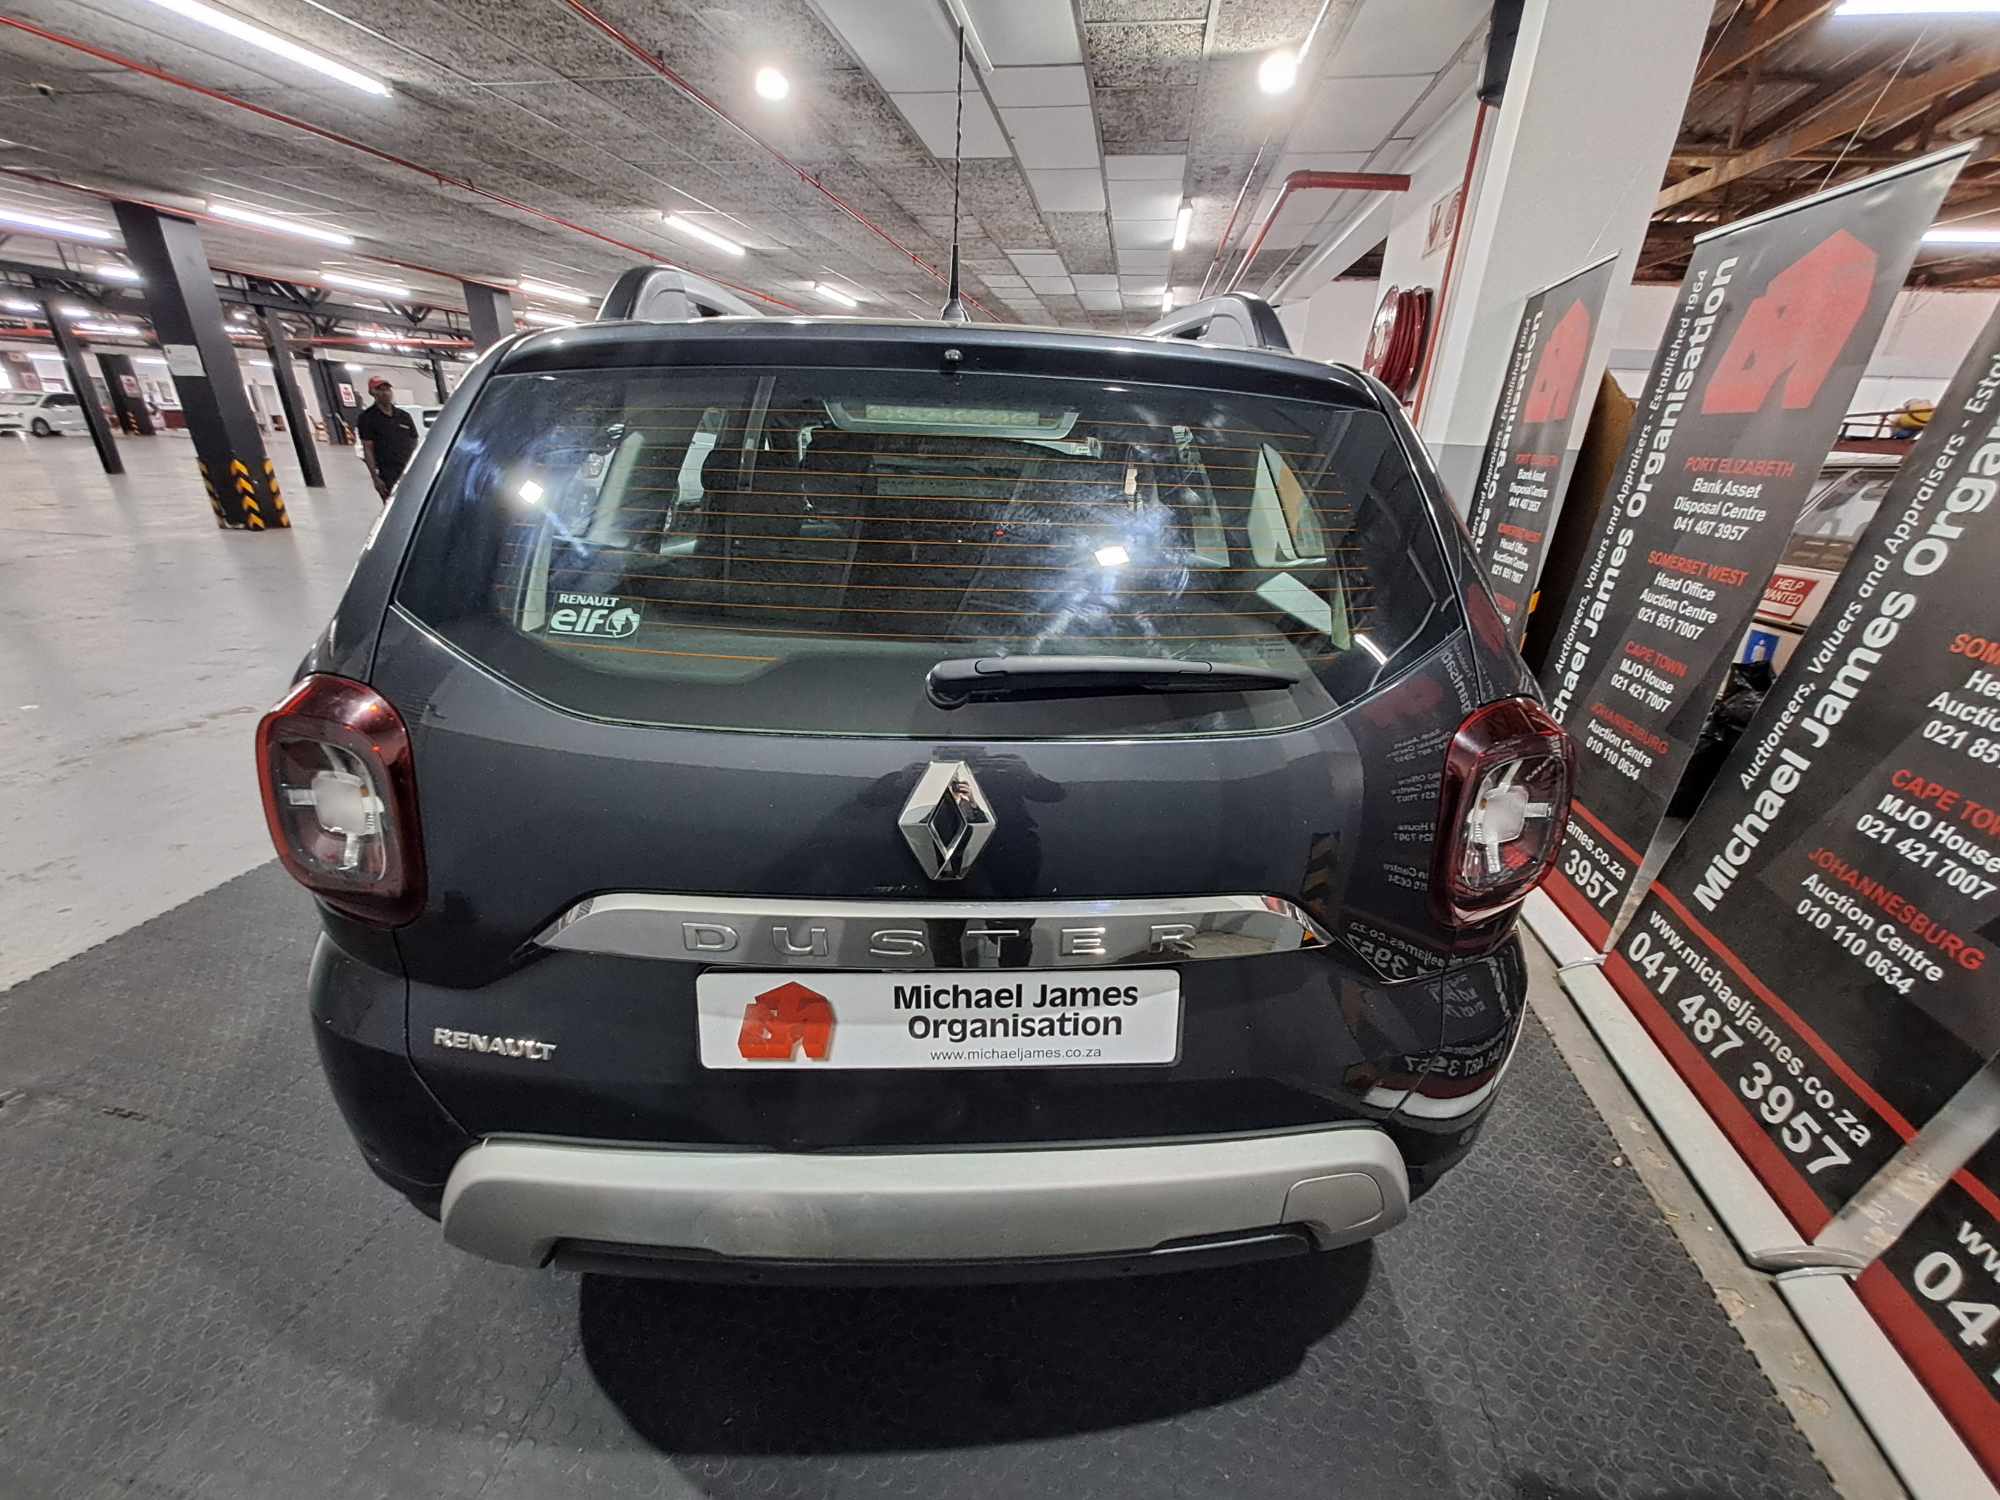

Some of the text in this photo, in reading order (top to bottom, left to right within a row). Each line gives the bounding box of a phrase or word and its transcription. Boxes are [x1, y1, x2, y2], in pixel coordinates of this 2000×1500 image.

[1487, 310, 1544, 500] Organisation
[1584, 527, 1635, 638] James
[1626, 256, 1740, 518] Organisation
[1684, 456, 1796, 478] PORT ELIZABETH
[1555, 594, 1590, 675] Auctioneers,
[1584, 537, 1610, 589] Valuers
[1606, 505, 1621, 536] and
[1617, 424, 1651, 503] Appraisers
[1649, 317, 1691, 412] Established
[1685, 269, 1708, 313] 1964
[1692, 477, 1764, 499] Bank Asset
[1673, 495, 1767, 522] Disposal Centre
[1673, 515, 1750, 542] 041 487 3957
[1648, 550, 1749, 587] SOMERSET WEST
[1654, 571, 1717, 602] Head Office
[1774, 577, 1806, 592] HELP
[550, 607, 608, 633] elf
[558, 592, 620, 608] RENAULT
[1639, 588, 1718, 625] Auction Centre
[1740, 680, 1817, 791] Auctioneers,
[1807, 600, 1863, 676] Valuers
[1857, 553, 1891, 605] and
[1884, 433, 1966, 555] Appraisers
[1637, 607, 1705, 641] 021 851 7007
[1618, 657, 1676, 695] MJO House
[1624, 640, 1689, 679] CAPE TOWN
[1610, 673, 1673, 714] 021 421 7007
[1585, 735, 1642, 782] 010 110 0634
[1587, 718, 1654, 769] Auction Centre
[1691, 748, 1812, 913] Michael
[1800, 590, 1918, 749] James
[1922, 719, 2000, 768] 021 85
[1891, 768, 1960, 813] CAPE
[1566, 815, 1628, 883] ames.co.za
[1876, 792, 2000, 874] MJO House
[1855, 813, 1998, 901] 021 421 7007
[1564, 849, 1619, 909] 3957
[1801, 872, 1944, 982] Auction Centre
[1808, 847, 1986, 971] JOHANNESBURG
[681, 922, 1197, 958] DUSTER
[1796, 898, 1915, 995] 010 110 0634
[893, 983, 1139, 1010] Michael James
[433, 1027, 558, 1061] RENAULT
[908, 1011, 1123, 1043] Organisation
[1649, 909, 1872, 1148] www.michaeljames.co.za
[929, 1046, 1102, 1062] www.michaeljames.co.za
[1628, 931, 1852, 1176] 041 487 3957
